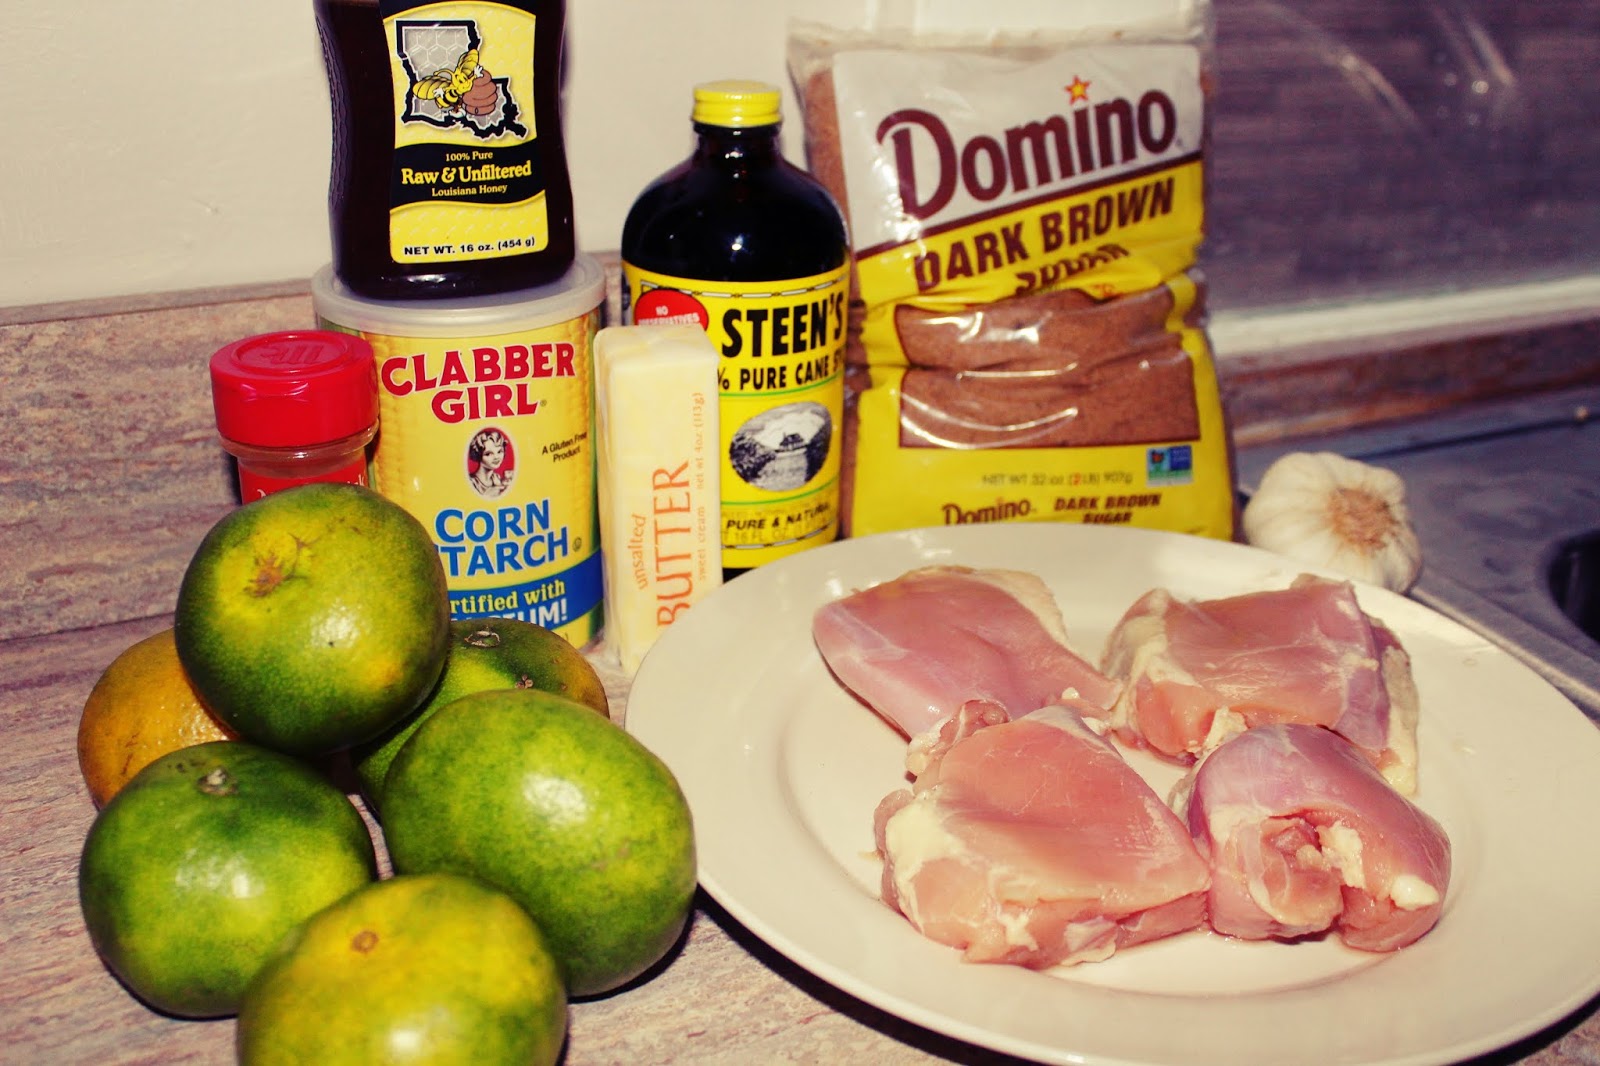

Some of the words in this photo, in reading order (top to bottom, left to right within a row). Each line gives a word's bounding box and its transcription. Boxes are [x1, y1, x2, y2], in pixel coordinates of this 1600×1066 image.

[446, 153, 470, 162] 100%
[472, 151, 493, 160] Pure
[875, 87, 1177, 221] Domino
[401, 168, 439, 184] Raw
[441, 167, 457, 183] &
[458, 160, 532, 182] Unfiltered
[432, 187, 477, 197] Louisiana
[479, 184, 508, 194] Honey
[404, 246, 430, 255] NET
[433, 245, 455, 255] WT.
[459, 244, 474, 253] 16
[497, 238, 522, 251] (454
[525, 236, 535, 247] g)
[913, 222, 1029, 292] DARK
[1039, 177, 1175, 254] BROWN
[655, 305, 669, 316] NO
[721, 291, 844, 359] STEEN'S
[380, 342, 576, 397] CLABBER
[739, 366, 787, 391] PURE
[795, 355, 829, 386] CANE
[431, 383, 539, 424] GIRL
[541, 445, 549, 455] A
[549, 438, 574, 453] Gluten
[574, 431, 588, 443] Free
[553, 445, 581, 463] Product
[941, 497, 1031, 526] Domino
[1054, 496, 1100, 511] DARK
[1104, 492, 1162, 510] BROWN
[435, 499, 550, 543] CORN
[697, 506, 706, 543] cream
[726, 519, 766, 531] PURE
[772, 517, 780, 528] &
[1081, 511, 1133, 526] SUGAR
[434, 526, 568, 577] TARCH
[627, 514, 648, 591] unsalted
[651, 461, 693, 627] BUTTER
[696, 548, 707, 581] sweet
[523, 579, 566, 606] with
